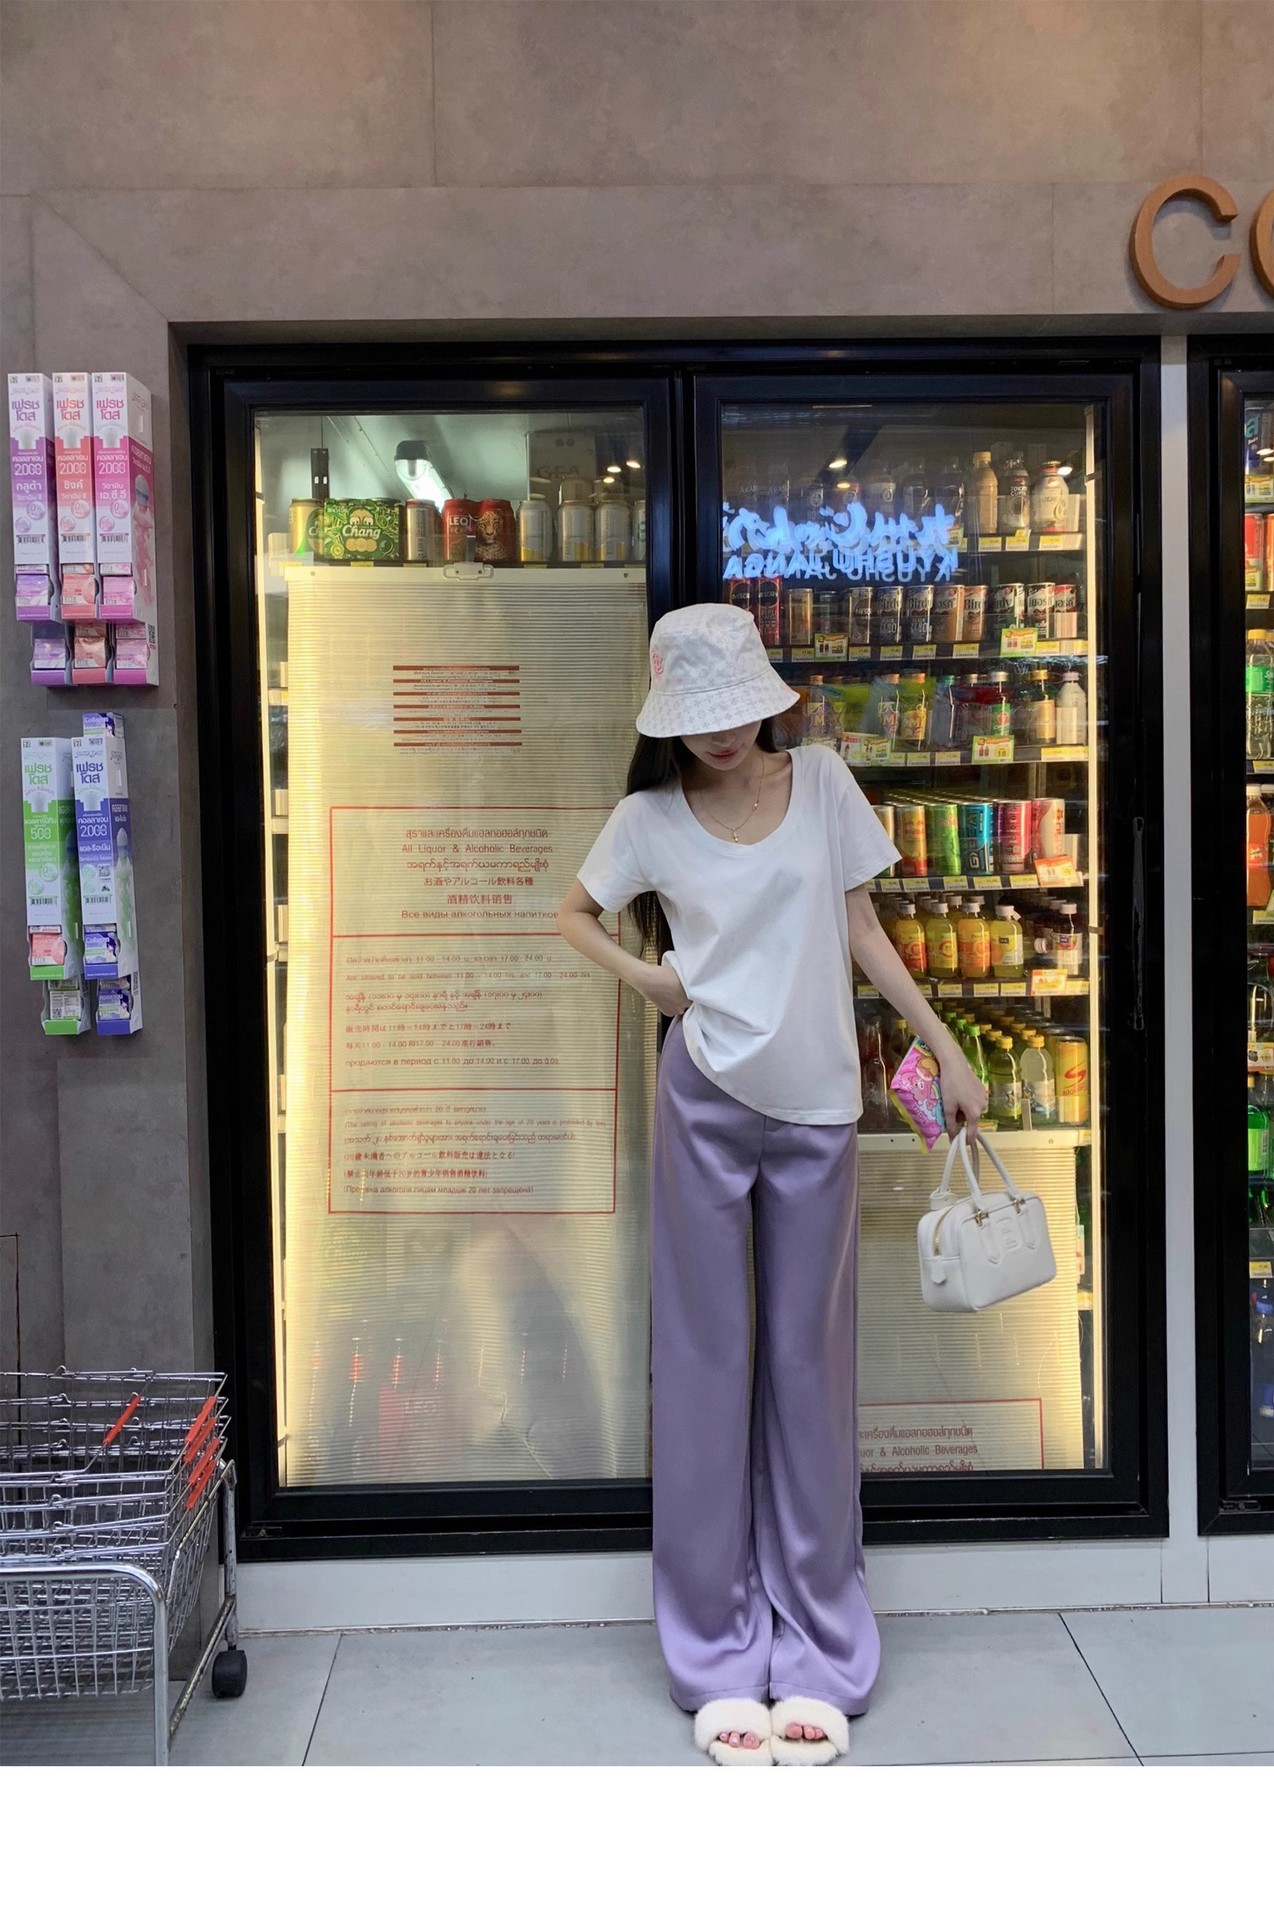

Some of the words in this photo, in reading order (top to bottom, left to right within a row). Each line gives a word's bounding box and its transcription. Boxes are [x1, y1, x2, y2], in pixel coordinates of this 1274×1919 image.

[1129, 174, 1274, 310] C
[449, 517, 469, 526] LEO
[342, 525, 381, 540] Chang
[76, 762, 103, 773] เฟรช
[81, 772, 100, 784] โดส
[402, 844, 413, 853] All
[419, 844, 446, 855] Liquor
[453, 844, 459, 853] &
[465, 844, 504, 853] Alcoholic
[510, 844, 553, 855] Beverages
[424, 876, 534, 886] お酒やアルコール飲料各種
[401, 910, 420, 919] Все
[423, 911, 448, 920] виды
[469, 1185, 476, 1193] 20
[860, 1448, 874, 1458] uor
[880, 1448, 887, 1457] &
[892, 1446, 930, 1457] Alcoholic
[935, 1444, 978, 1457] Beverages
